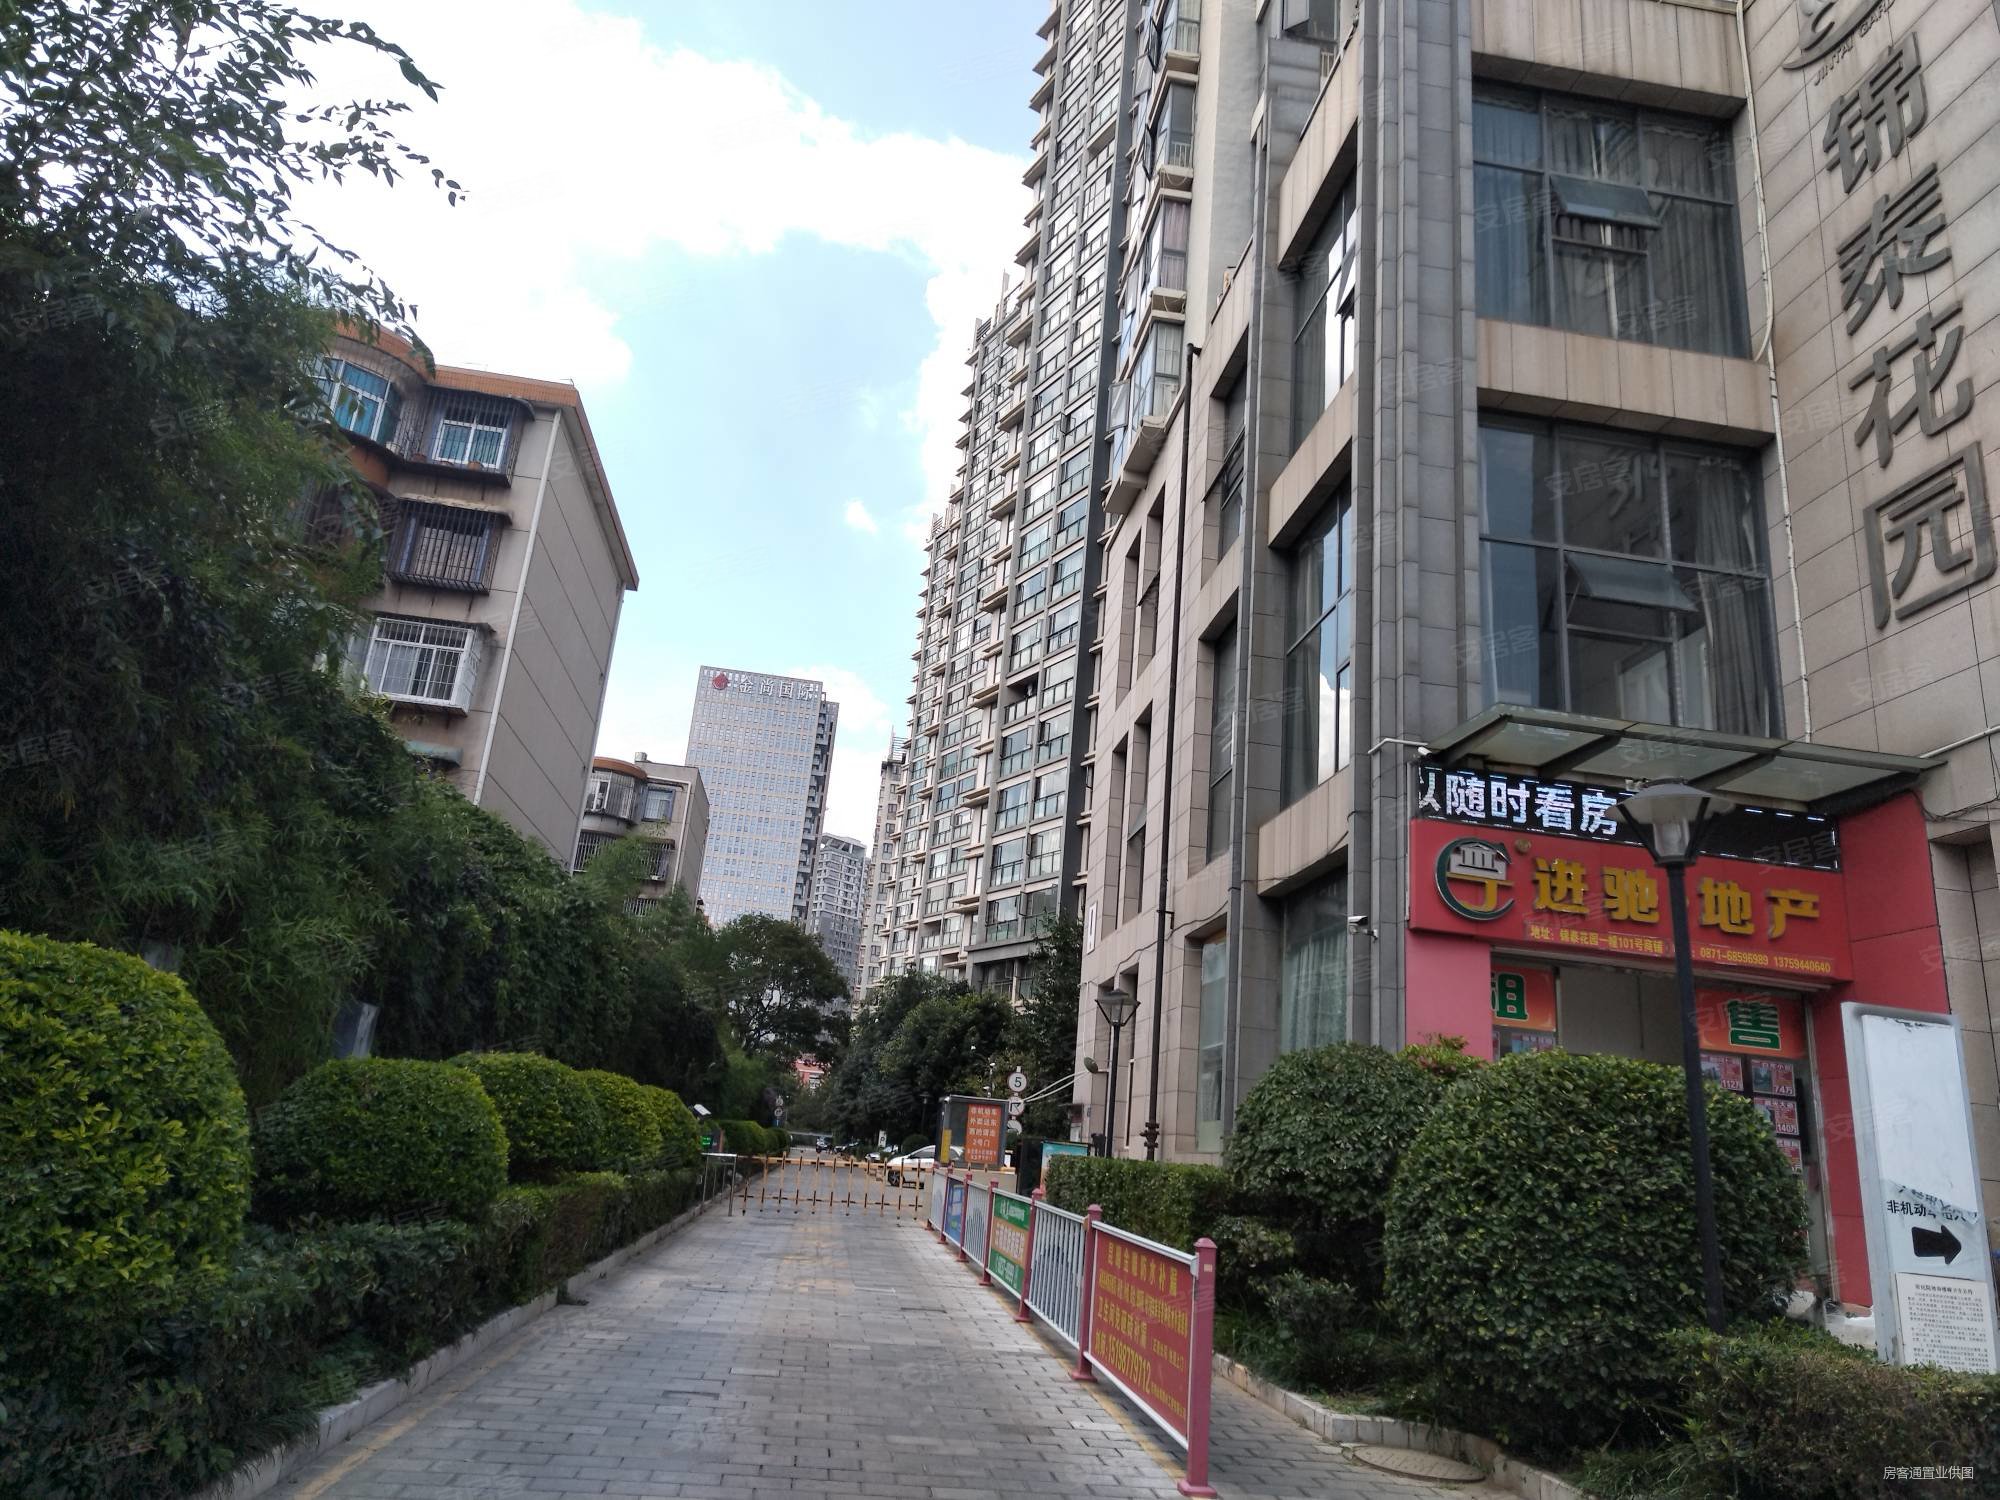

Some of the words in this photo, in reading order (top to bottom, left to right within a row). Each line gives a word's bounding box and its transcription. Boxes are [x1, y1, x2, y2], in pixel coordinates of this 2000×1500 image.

[1823, 31, 1999, 630] 锦泰花园
[738, 674, 813, 702] 金尚国际
[1726, 1000, 1781, 1050] 售
[1014, 1076, 1022, 1088] 5
